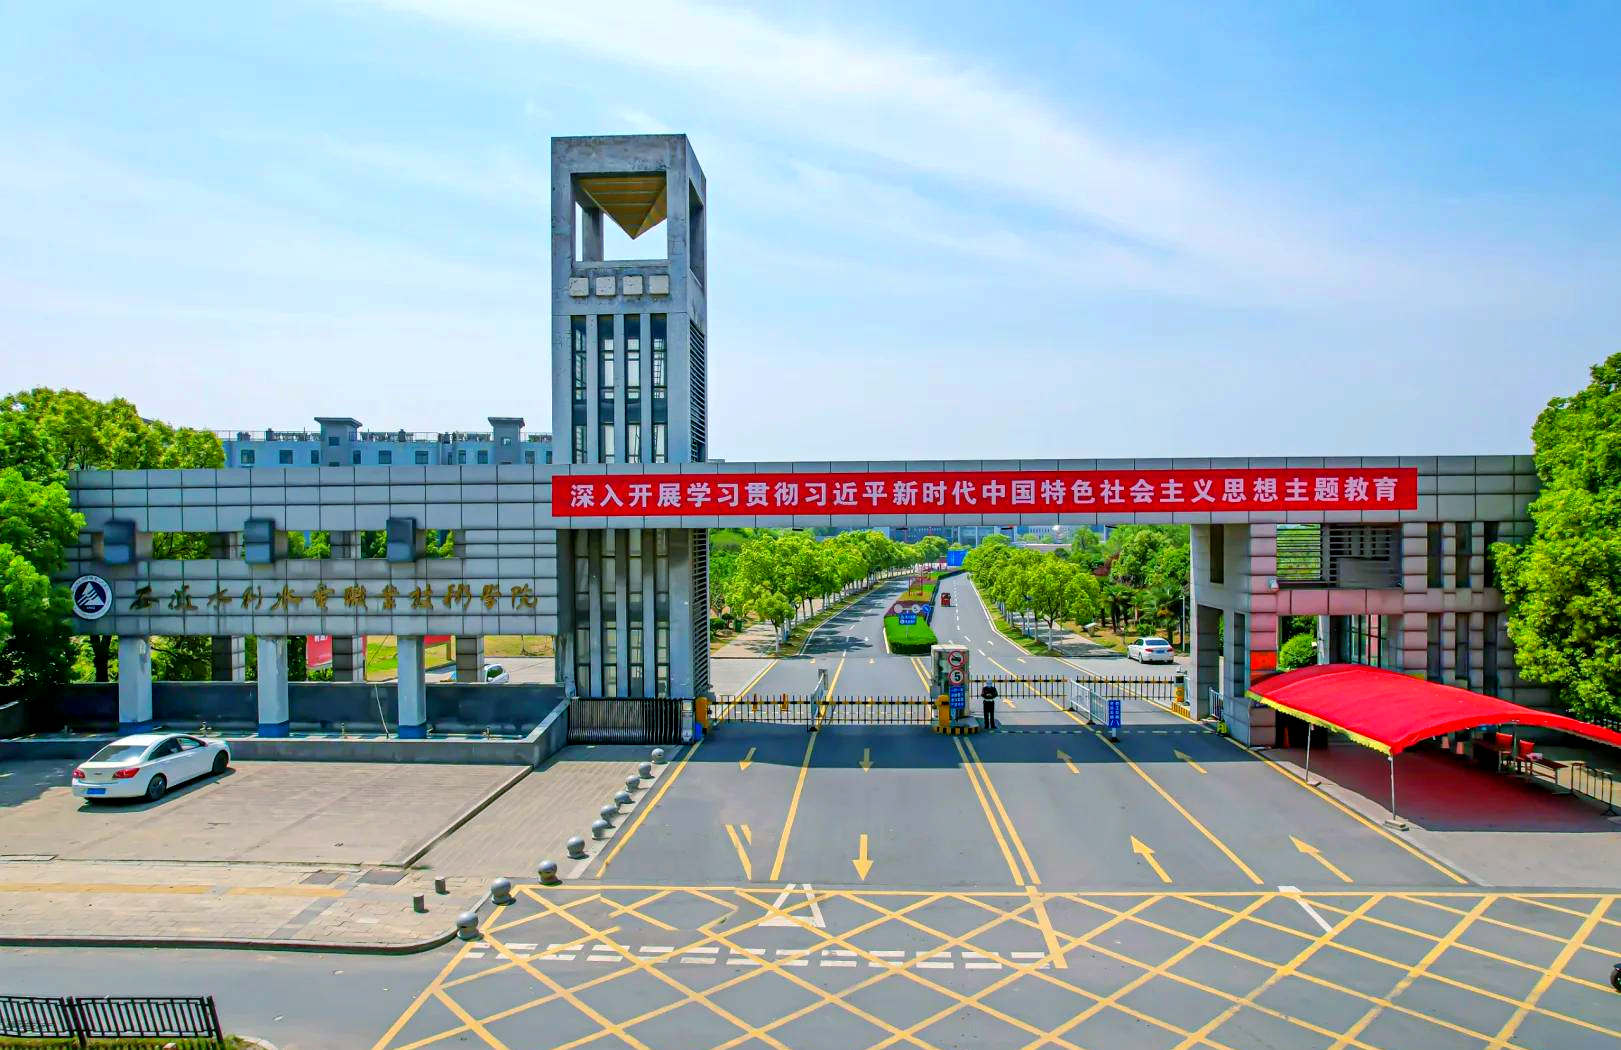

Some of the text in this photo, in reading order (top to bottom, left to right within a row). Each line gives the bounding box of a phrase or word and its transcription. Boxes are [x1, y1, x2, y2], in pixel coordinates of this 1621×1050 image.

[570, 476, 1398, 508] 深入开展学习贯彻习近平新时代中国特色社会主义思想主题教育
[954, 672, 961, 681] 5
